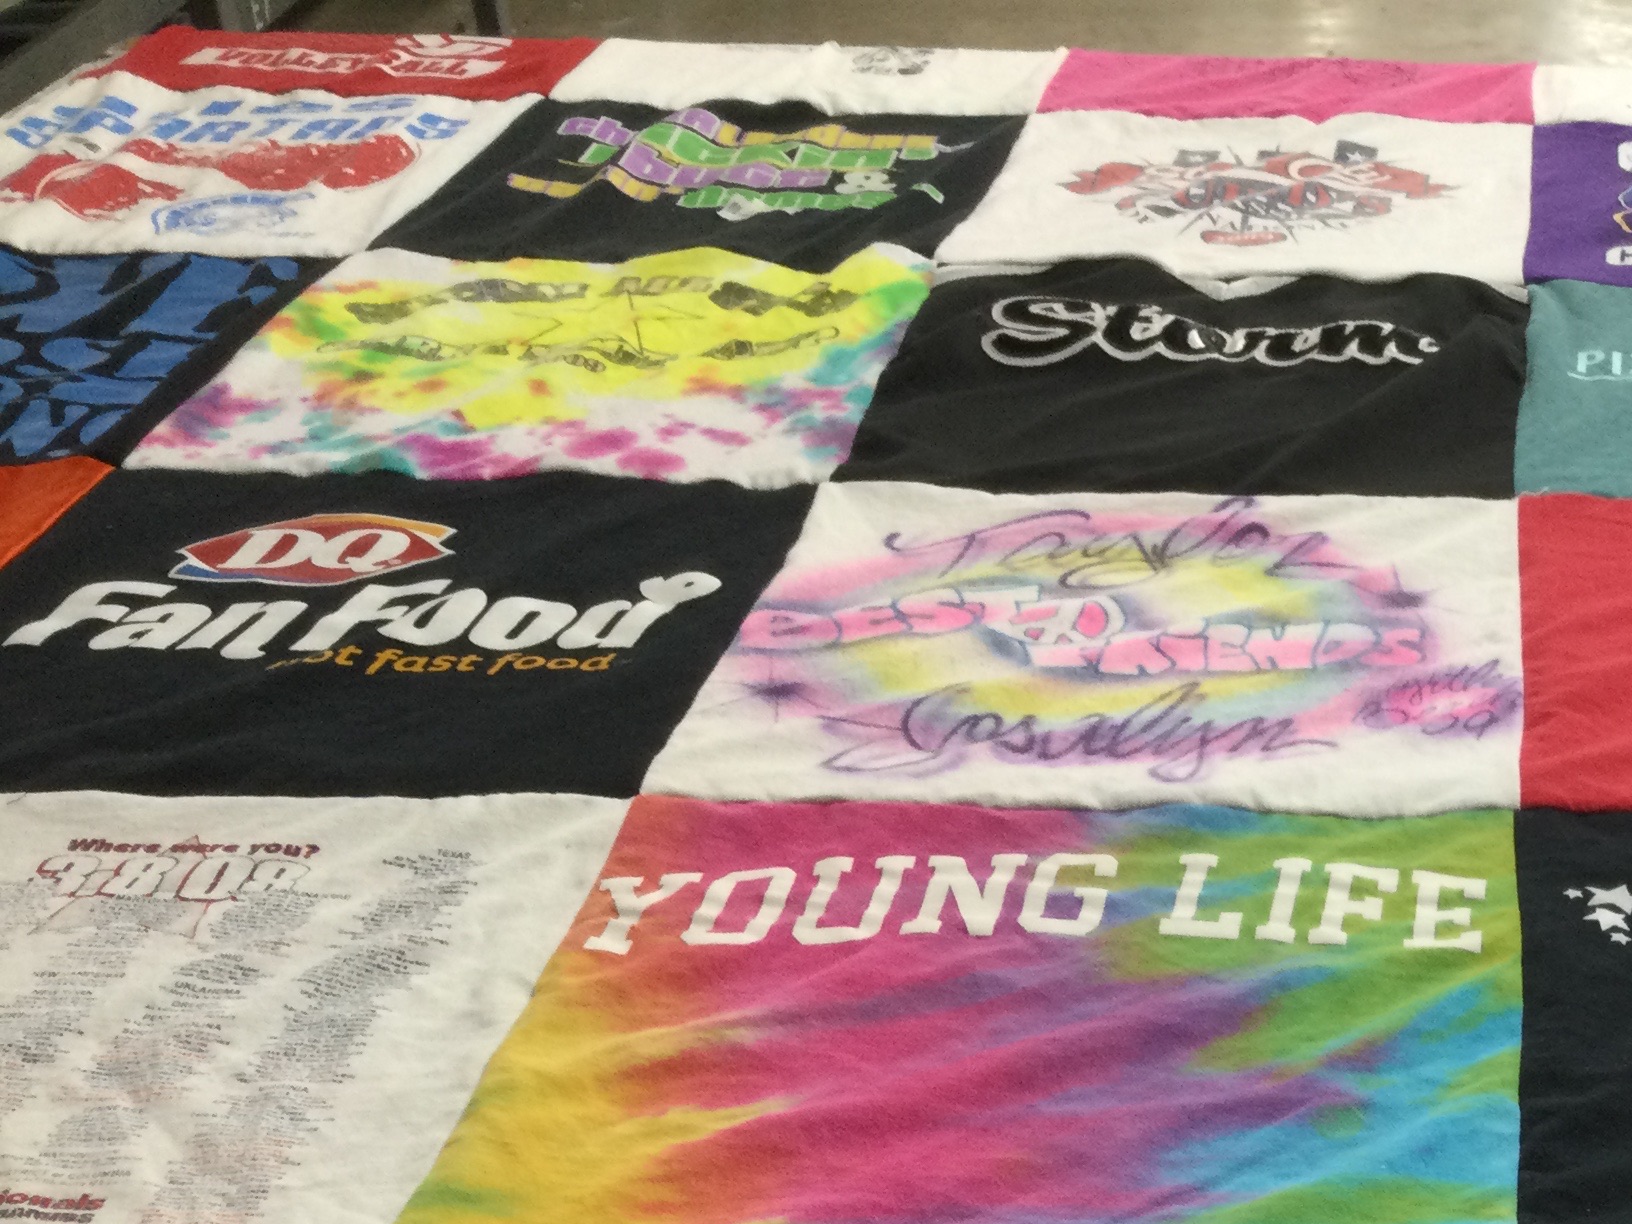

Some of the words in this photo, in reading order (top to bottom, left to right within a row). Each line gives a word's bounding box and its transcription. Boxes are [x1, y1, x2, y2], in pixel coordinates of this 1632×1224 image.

[215, 48, 469, 76] VOLLEYALL
[981, 296, 1441, 367] Storm
[214, 527, 412, 575] DQ
[2, 580, 294, 660] Fan
[290, 571, 724, 654] Food
[740, 585, 1042, 651] BEST
[1028, 620, 1428, 676] FRIENDS
[265, 645, 362, 671] ot
[364, 647, 484, 676] fast
[486, 651, 618, 676] food
[67, 838, 162, 854] Where
[247, 842, 321, 860] you?
[582, 852, 1119, 956] YOUNG
[1158, 852, 1488, 953] LIFE
